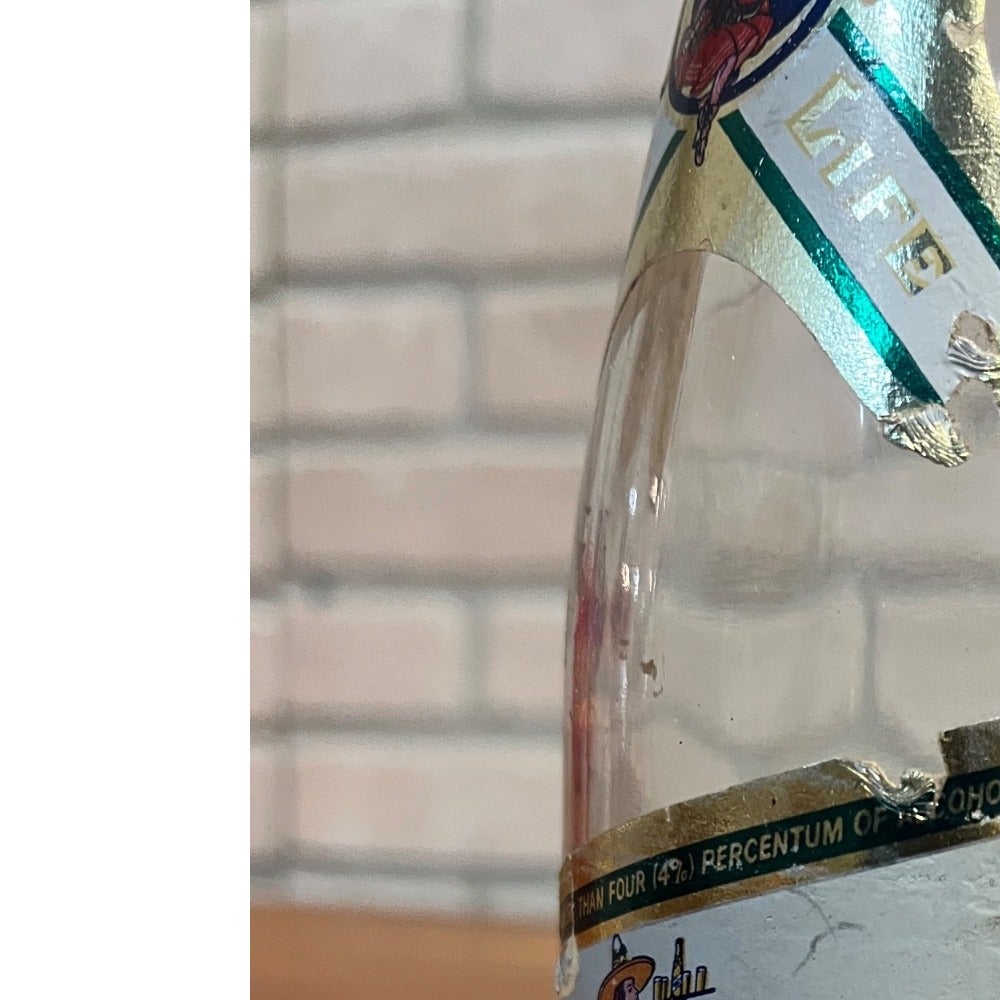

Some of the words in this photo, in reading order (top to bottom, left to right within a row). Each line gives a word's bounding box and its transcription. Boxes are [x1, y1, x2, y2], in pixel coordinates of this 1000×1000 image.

[783, 71, 957, 297] LIFE
[578, 886, 604, 918] THAN
[607, 870, 646, 905] FOUR
[652, 852, 695, 890] (4%)
[701, 817, 844, 875] PERCENTUM
[853, 807, 886, 837] OF
